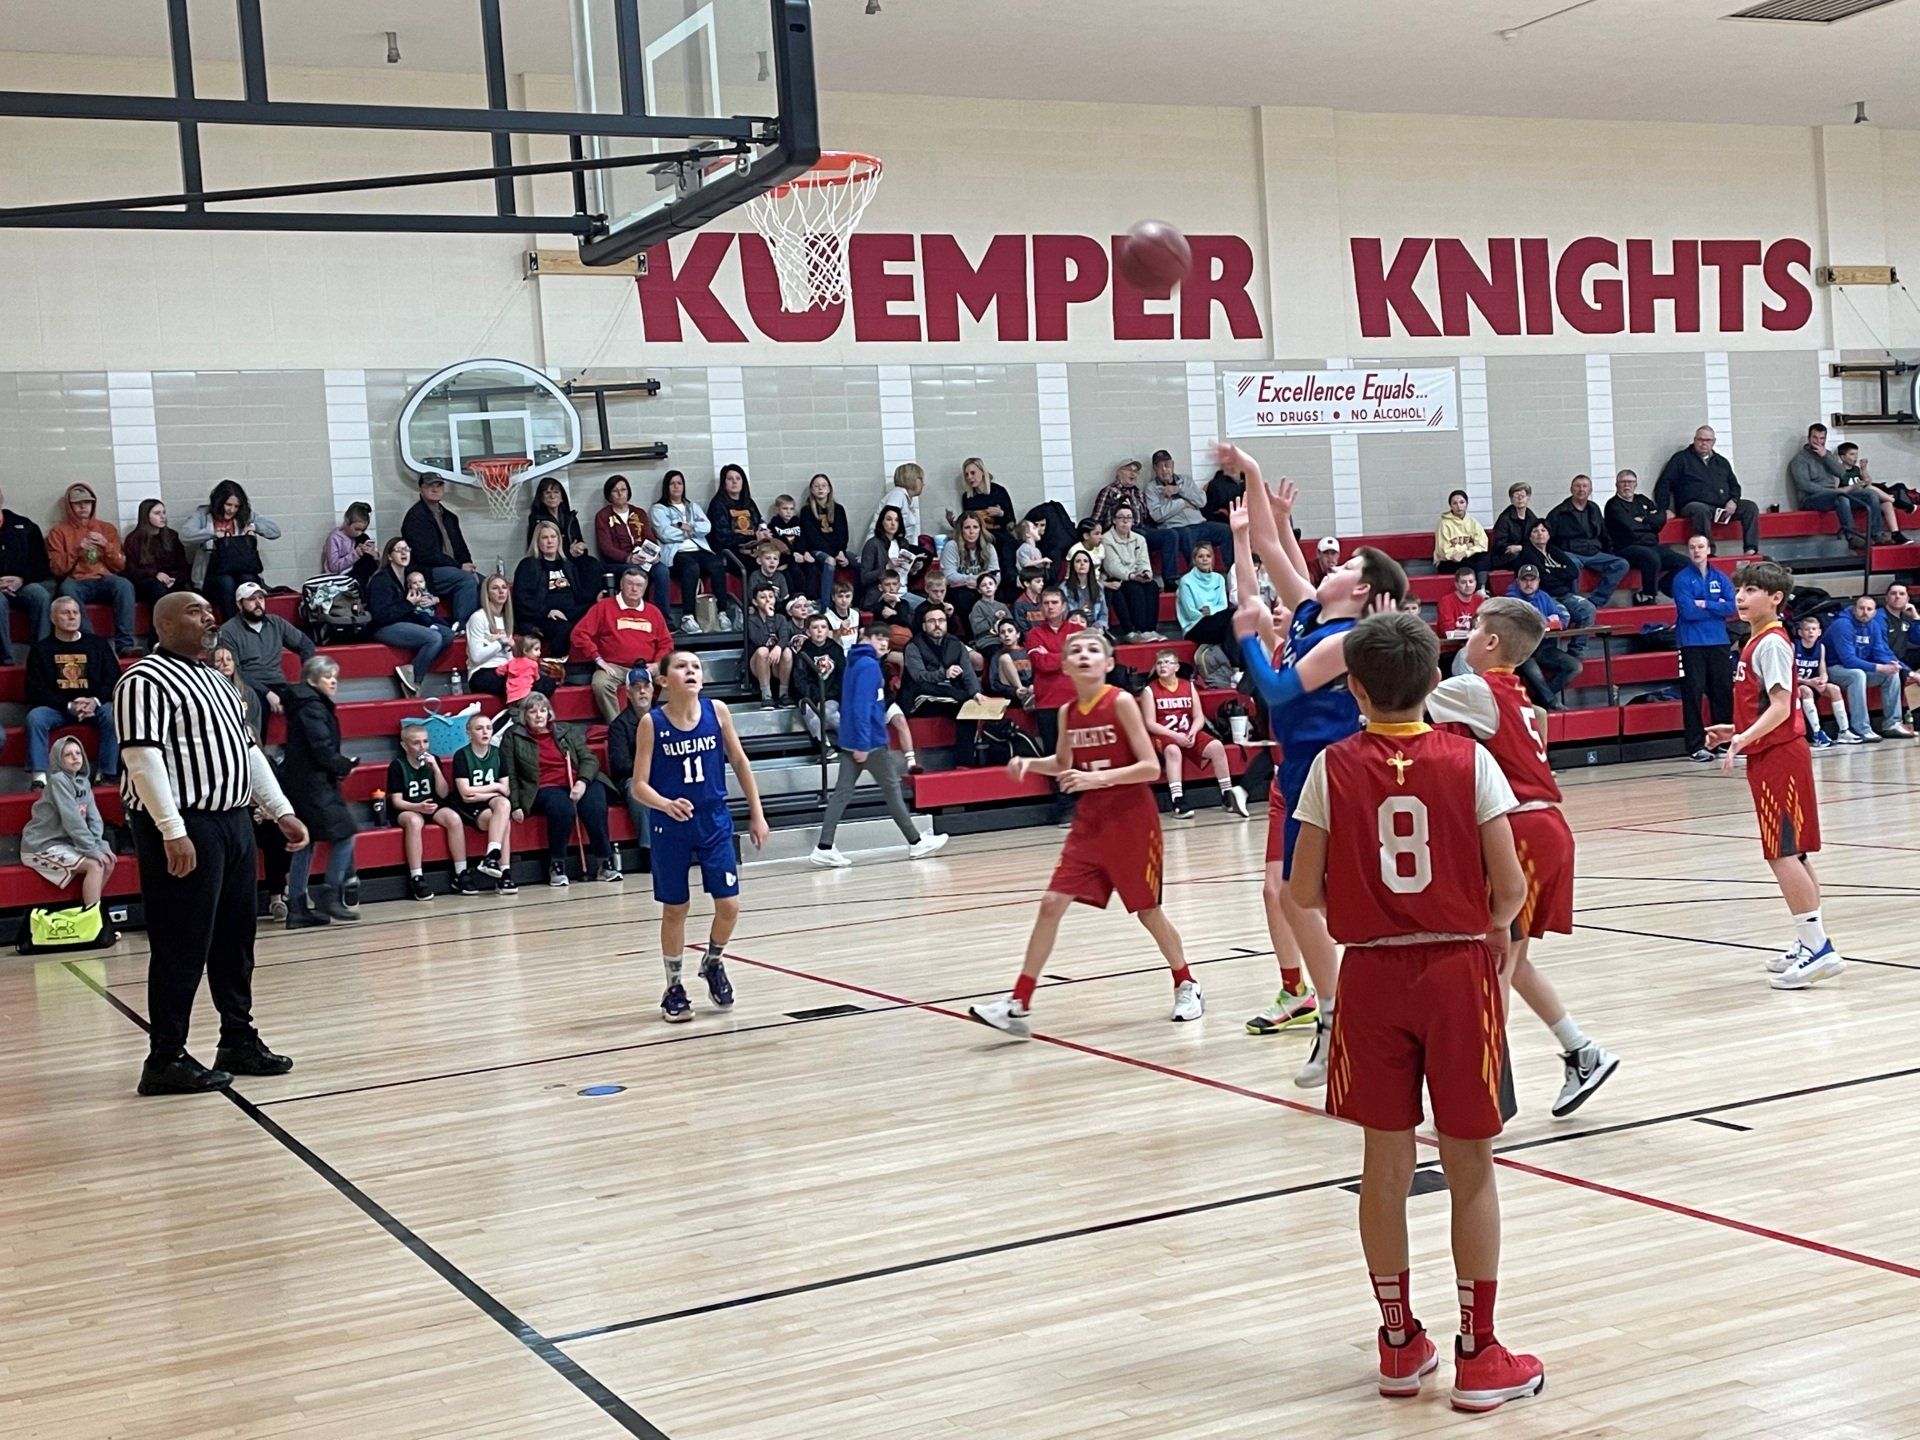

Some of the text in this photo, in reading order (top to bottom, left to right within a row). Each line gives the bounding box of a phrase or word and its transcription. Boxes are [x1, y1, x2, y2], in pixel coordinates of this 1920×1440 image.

[640, 233, 1812, 342] KUEMPER KNIGHTS
[1257, 372, 1428, 407] Excellence Equals...
[1257, 407, 1426, 423] NO DRUGS! NO ALCOHOL!
[662, 735, 717, 756] BLUEJAYS
[1520, 706, 1548, 763] 5
[473, 768, 495, 786] 24
[682, 755, 705, 783] 11
[409, 778, 431, 797] 23
[1378, 796, 1432, 893] 8
